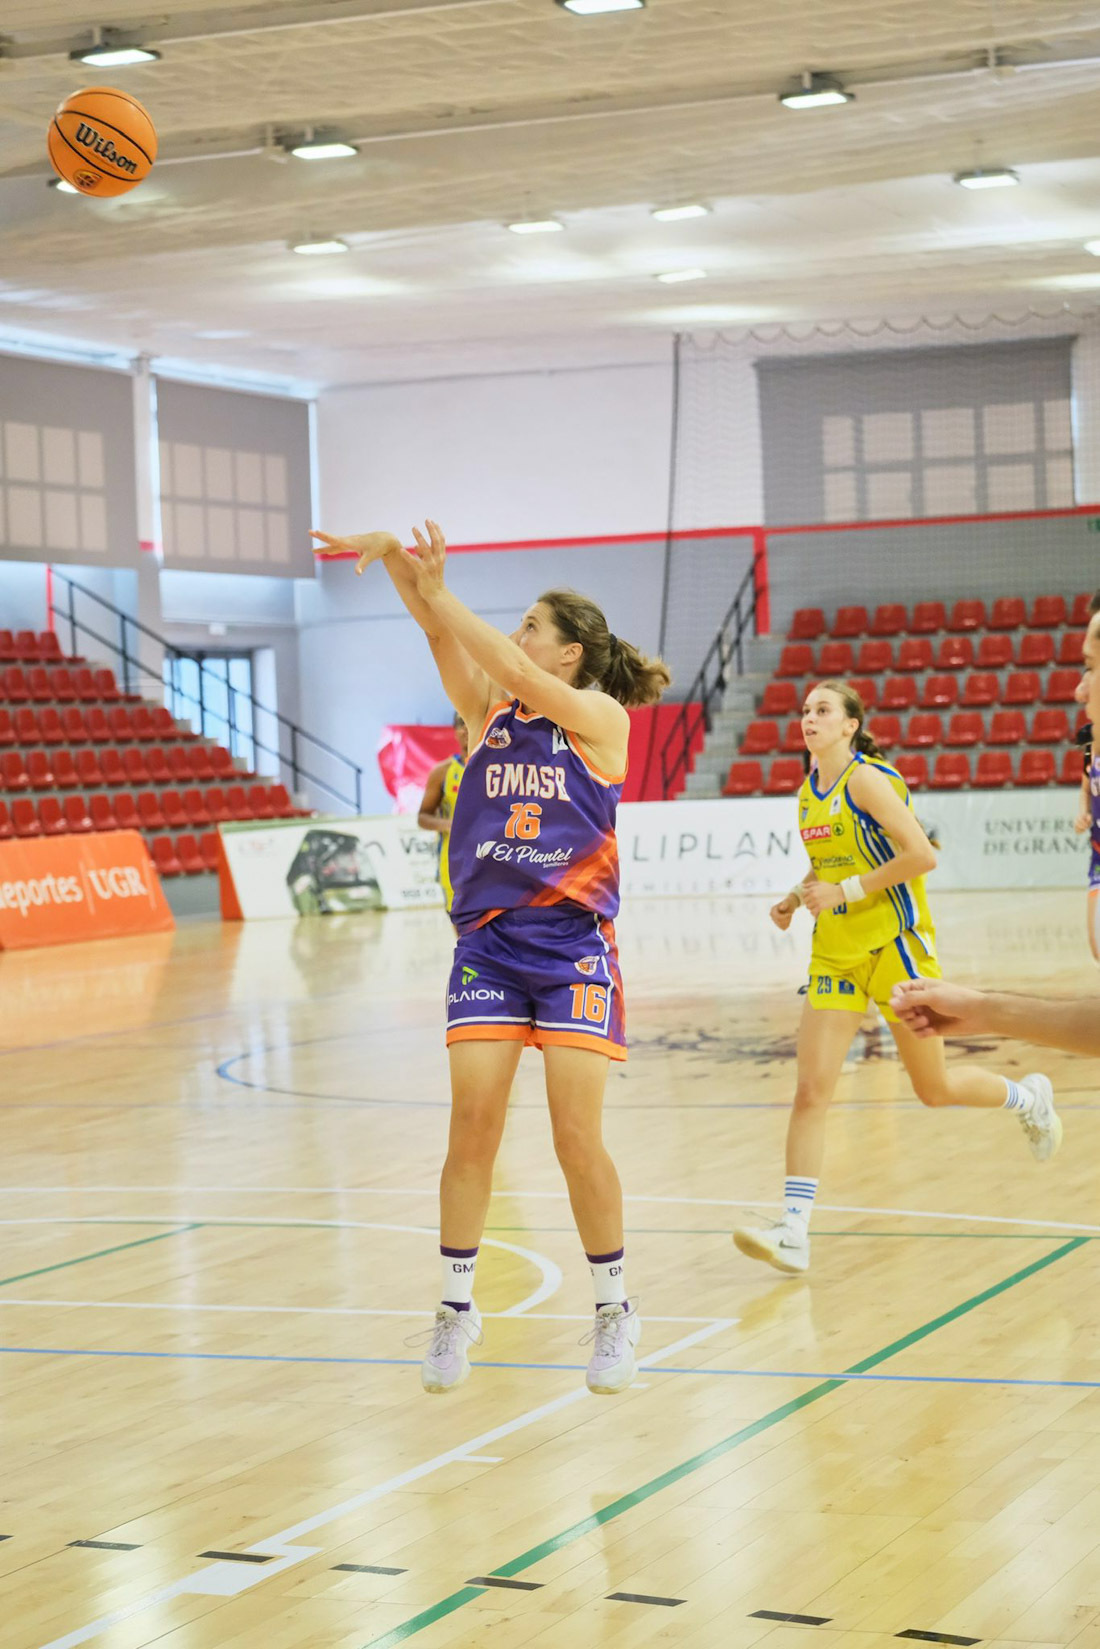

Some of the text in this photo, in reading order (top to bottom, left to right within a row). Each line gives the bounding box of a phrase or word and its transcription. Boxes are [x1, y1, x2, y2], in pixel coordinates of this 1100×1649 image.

[75, 121, 138, 175] Wilson
[504, 802, 542, 840] 16
[985, 819, 1075, 834] UNIVERS
[802, 825, 831, 841] SPAR
[493, 843, 573, 864] El Plantel
[633, 831, 792, 861] LIPLAN
[983, 839, 1008, 856] DE
[0, 866, 147, 917] eportes UGR
[817, 975, 832, 994] 29
[448, 988, 505, 1006] PLAION
[569, 983, 607, 1023] 16
[453, 1263, 475, 1273] GM
